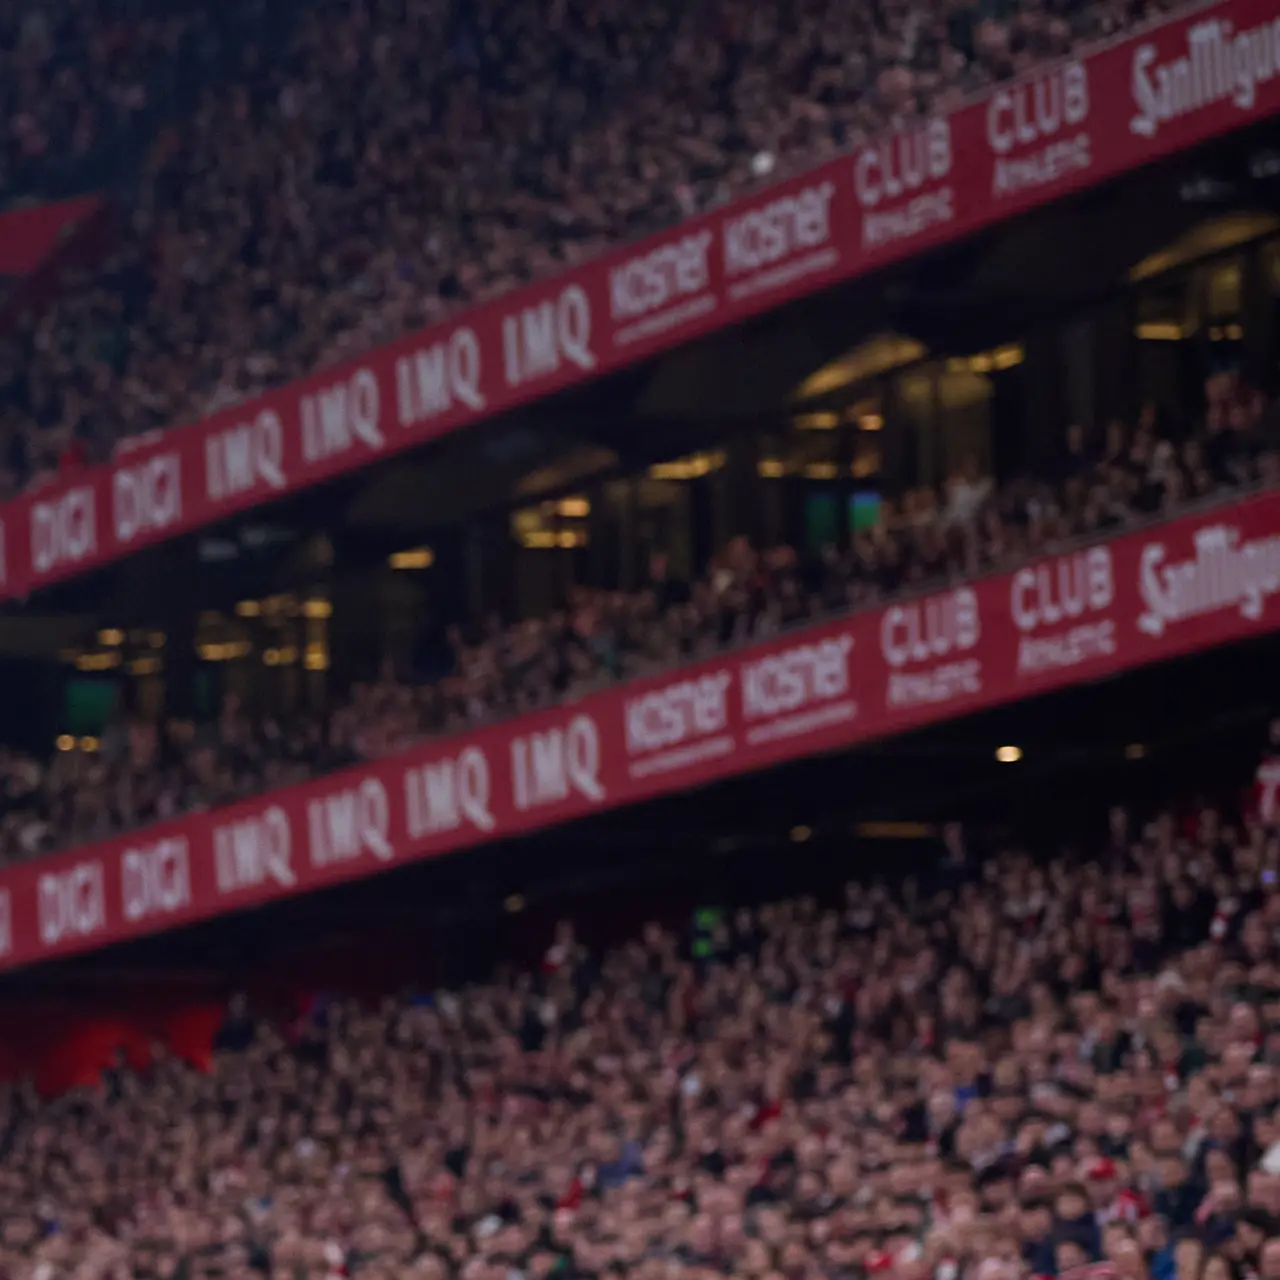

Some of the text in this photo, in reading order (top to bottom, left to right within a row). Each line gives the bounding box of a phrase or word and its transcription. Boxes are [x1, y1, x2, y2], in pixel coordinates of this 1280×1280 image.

[986, 60, 1089, 153] CLUB
[853, 118, 952, 206] CLUB
[397, 329, 485, 426] IMQ
[503, 285, 595, 386] IMQ
[206, 409, 286, 499] IMQ
[302, 368, 384, 462] IMQ
[881, 587, 979, 666] CLUB
[1011, 545, 1113, 631] CLUB
[405, 747, 495, 838] IMQ
[511, 715, 604, 810] IMQ
[214, 806, 296, 892] IMQ
[308, 778, 393, 866] IMQ
